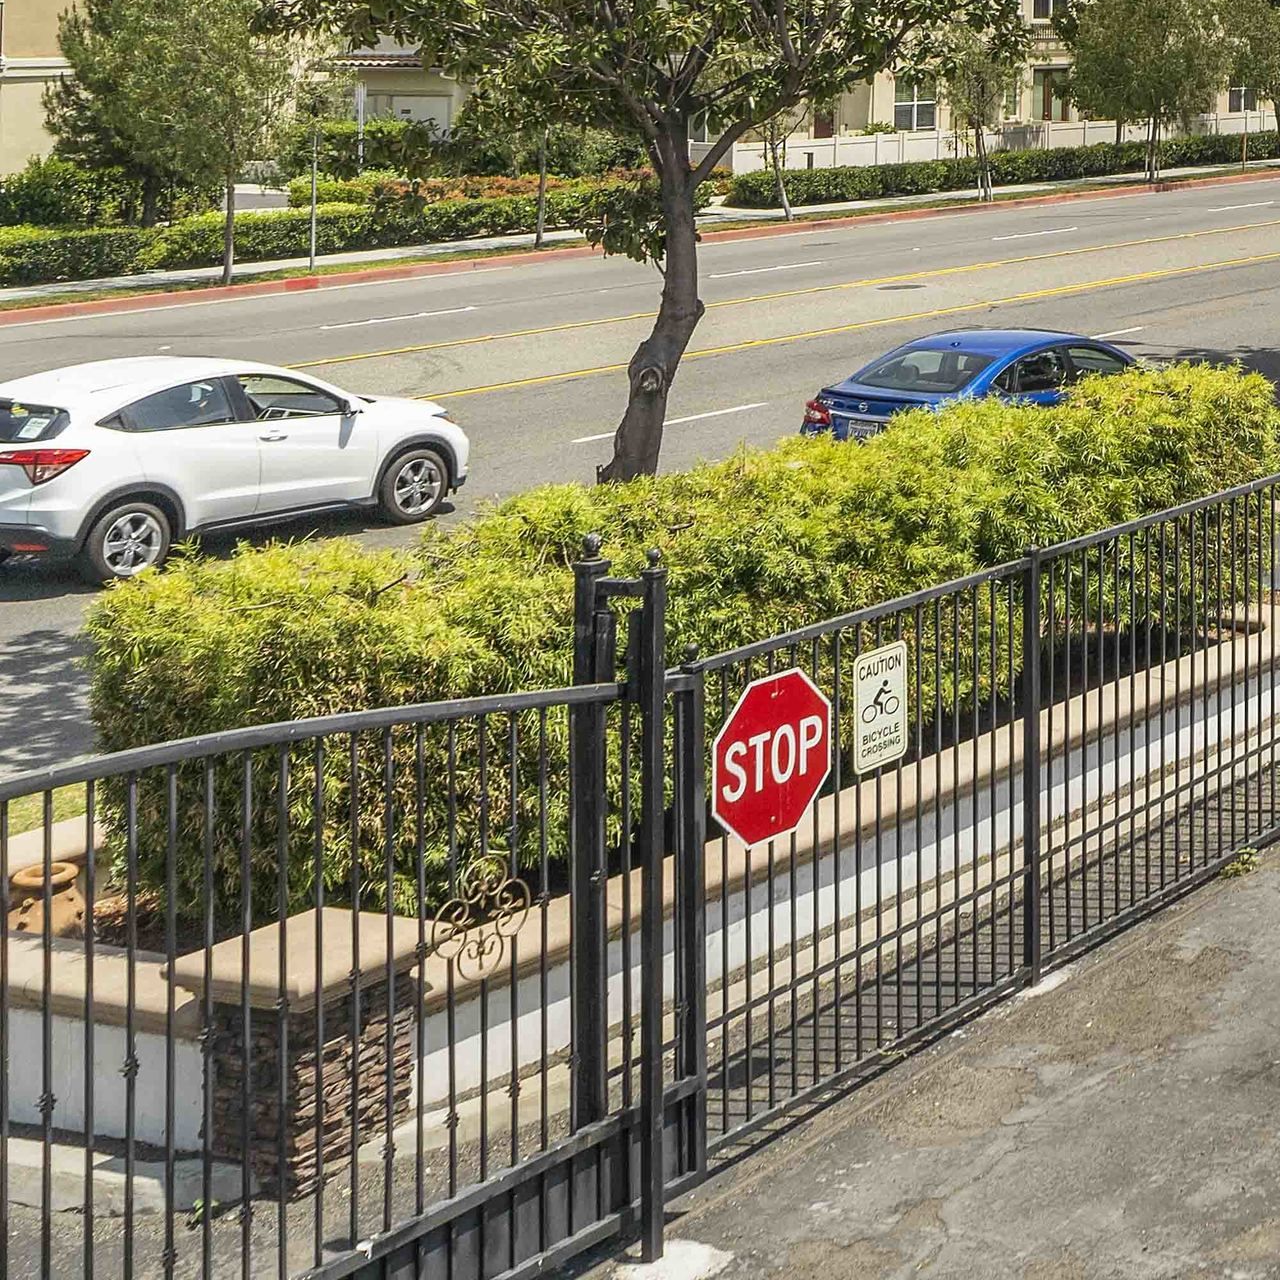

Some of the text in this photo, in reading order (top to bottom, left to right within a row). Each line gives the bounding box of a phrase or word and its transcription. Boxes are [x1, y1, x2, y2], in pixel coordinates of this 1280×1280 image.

[859, 653, 902, 681] CAUTION
[861, 735, 901, 758] CROSSING
[862, 722, 900, 746] BICYCLE
[722, 715, 823, 803] STOP
